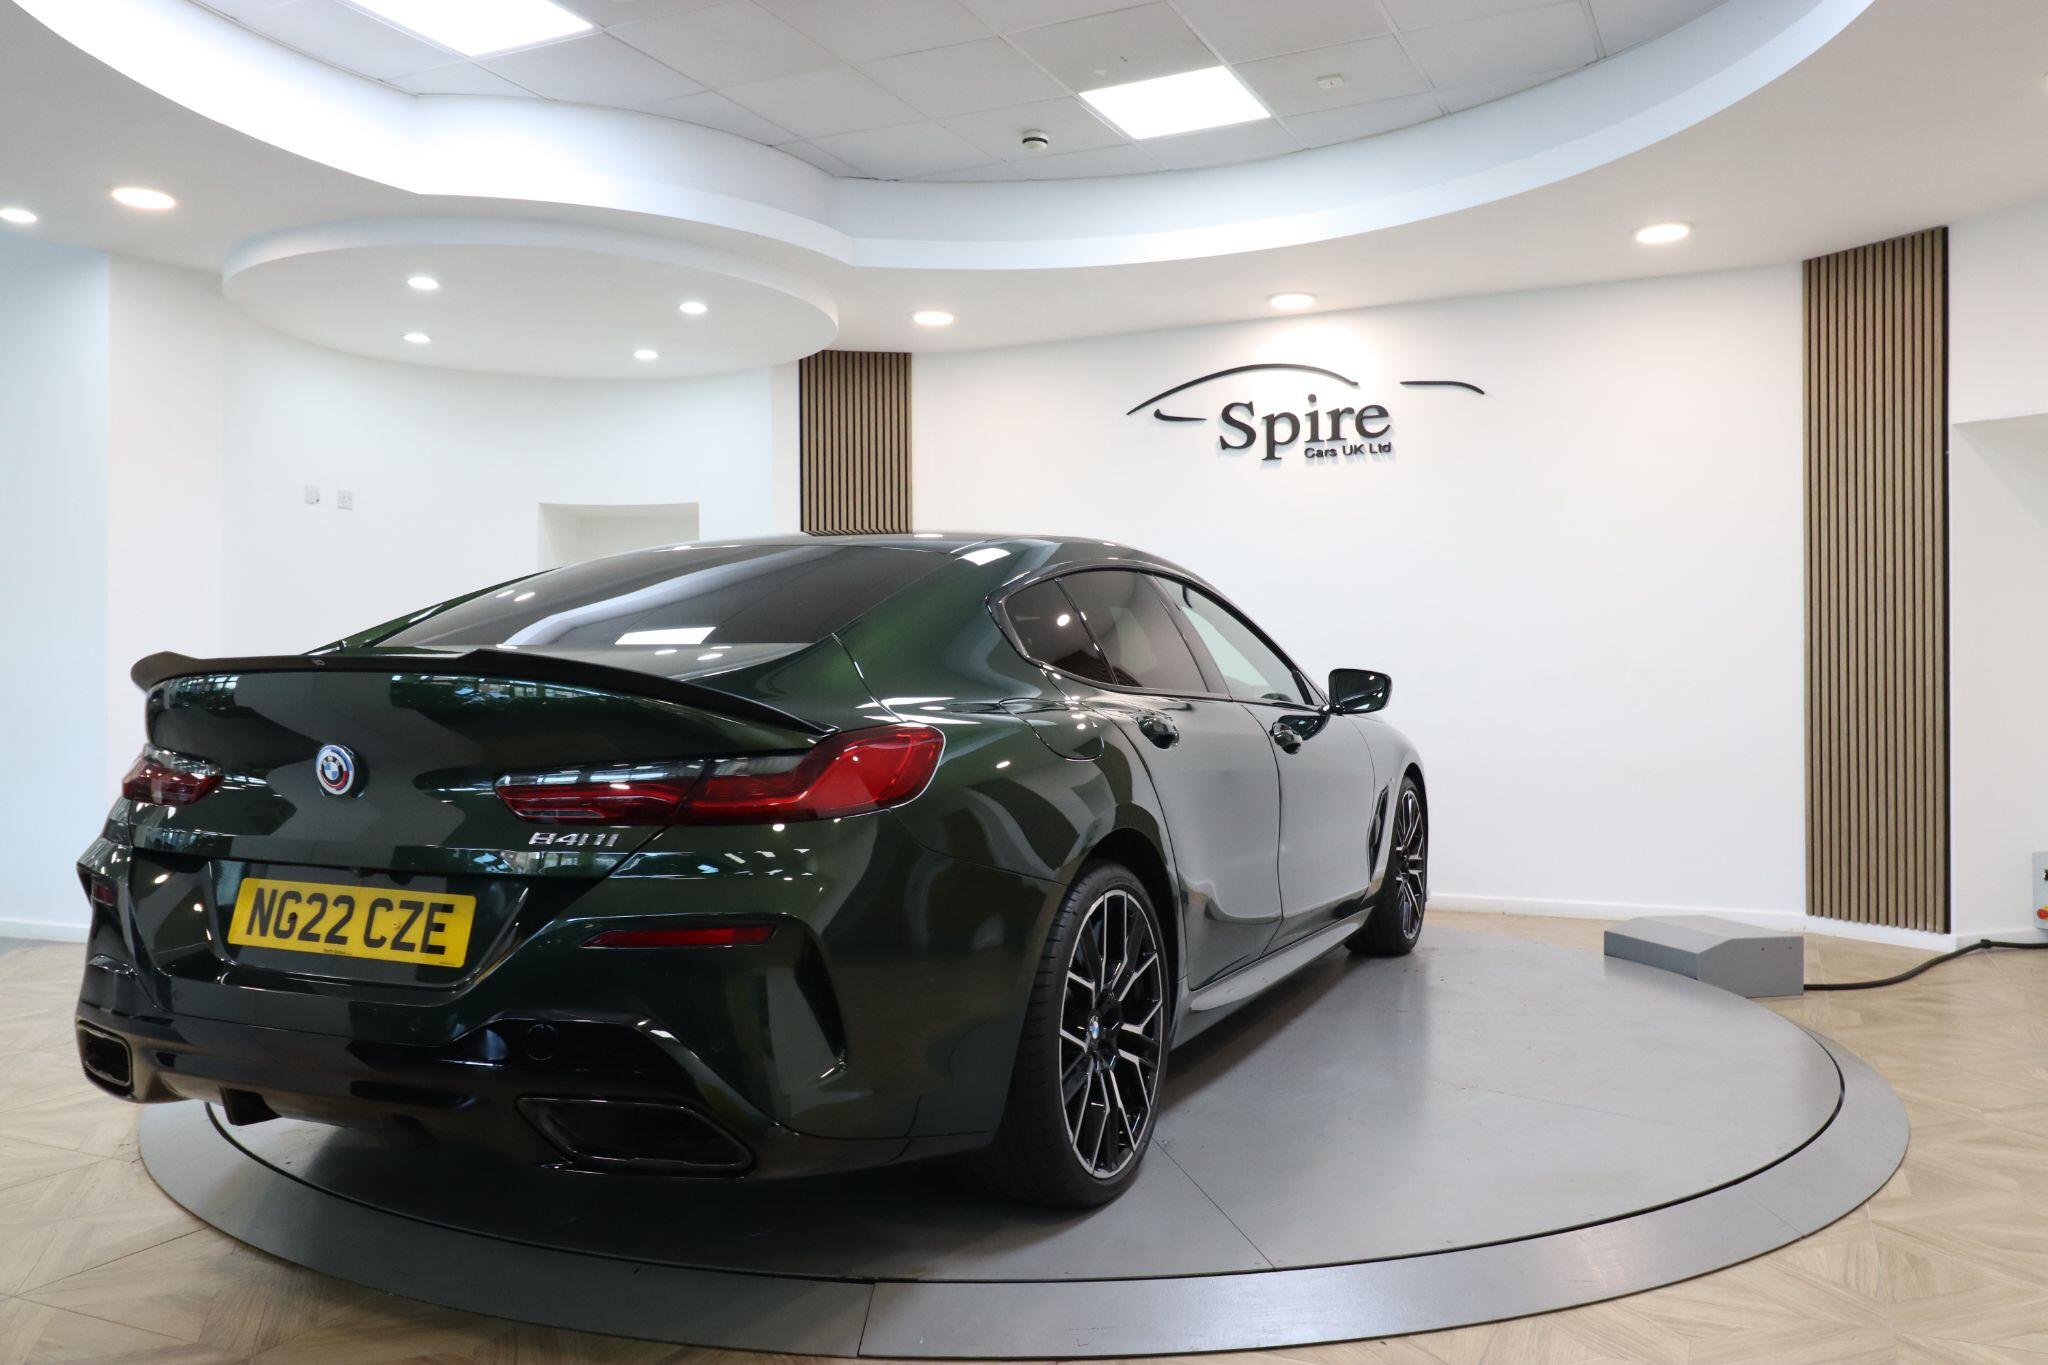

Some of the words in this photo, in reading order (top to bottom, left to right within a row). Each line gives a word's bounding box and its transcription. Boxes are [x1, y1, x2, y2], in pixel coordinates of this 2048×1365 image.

[1219, 394, 1391, 461] Spire
[1304, 447, 1338, 459] Cars
[1342, 444, 1364, 456] UK
[1369, 441, 1391, 454] Ltd
[246, 887, 355, 946] NG22
[363, 897, 455, 956] CZE
